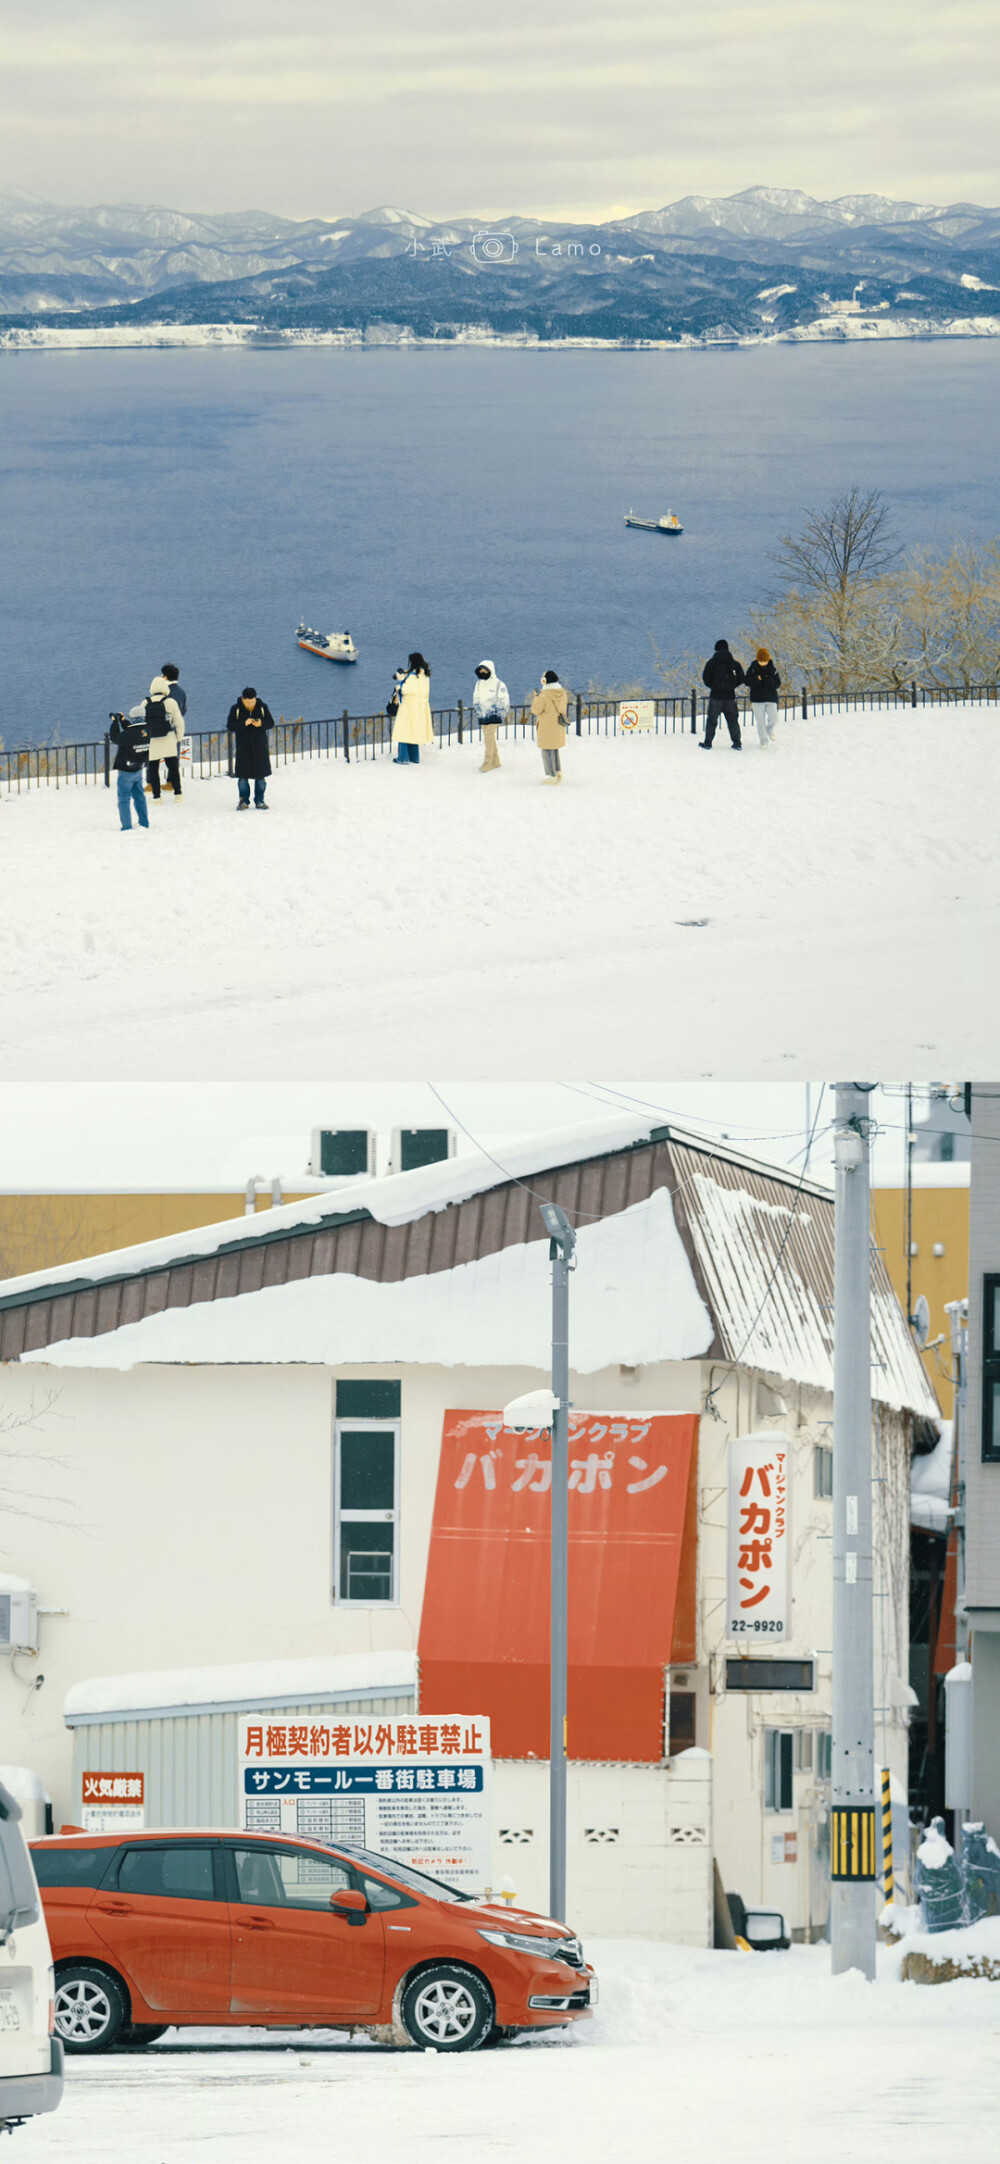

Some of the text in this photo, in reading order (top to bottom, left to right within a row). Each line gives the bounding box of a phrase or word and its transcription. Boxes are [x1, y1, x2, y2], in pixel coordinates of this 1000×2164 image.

[454, 1449, 669, 1494] バカポン
[775, 1453, 786, 1539] マージャンクラブ
[737, 1463, 775, 1609] バカポン
[731, 1619, 783, 1633] 22-9920
[244, 1723, 484, 1758] 月極契約者以外駐車禁止
[84, 1777, 142, 1798] 火気厳禁
[252, 1768, 477, 1791] サンモール一番街駐車場
